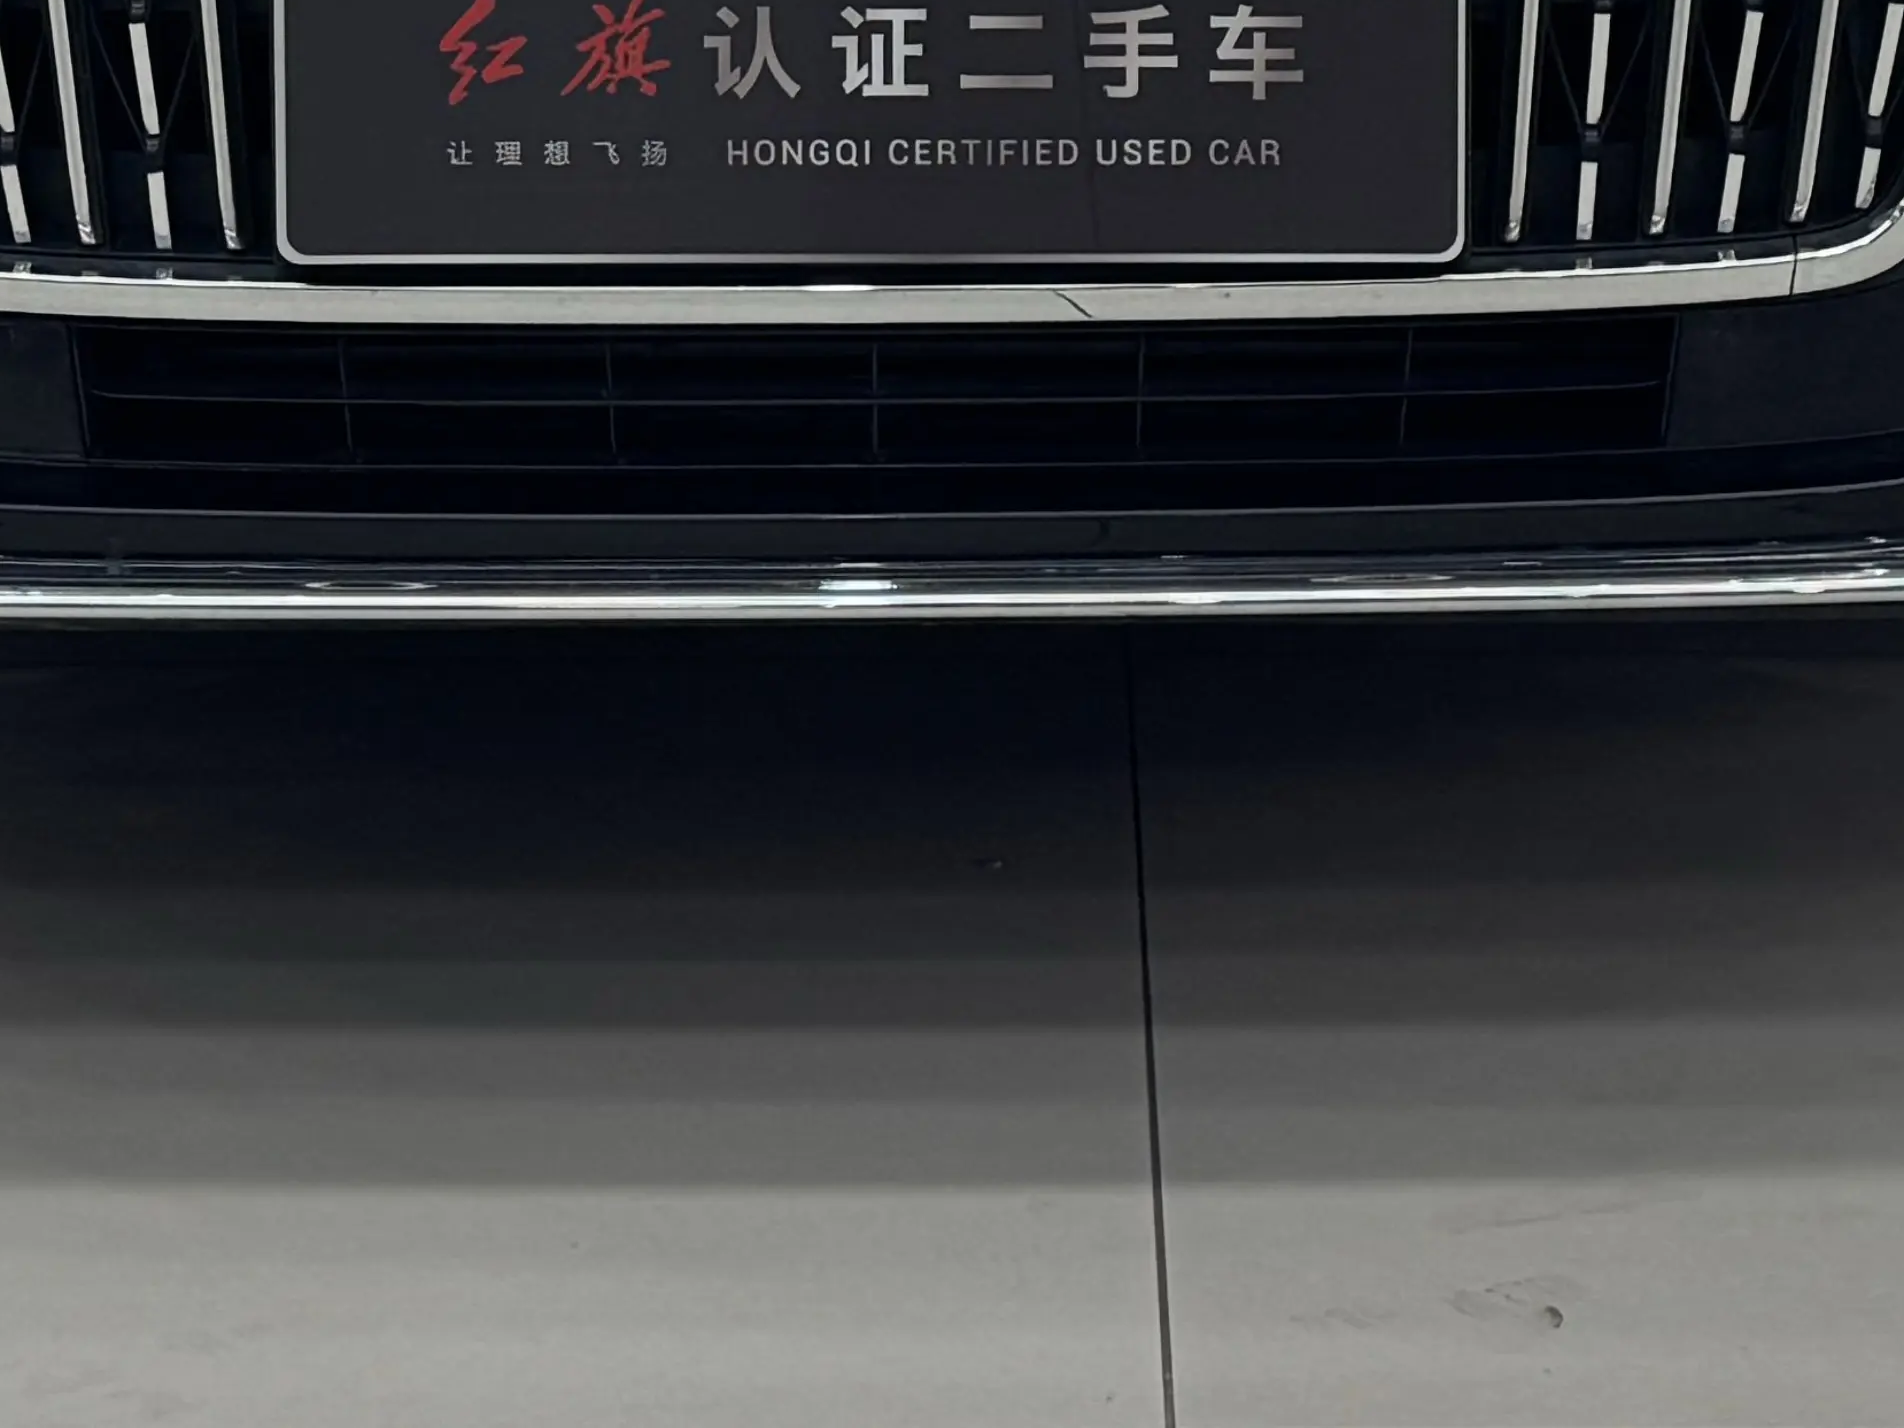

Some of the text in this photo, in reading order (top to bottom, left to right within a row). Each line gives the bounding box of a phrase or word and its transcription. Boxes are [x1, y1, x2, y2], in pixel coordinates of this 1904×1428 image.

[446, 140, 669, 167] 让理想飞扬
[727, 139, 1282, 167] HONGQI CERTIFIED USED CAR
